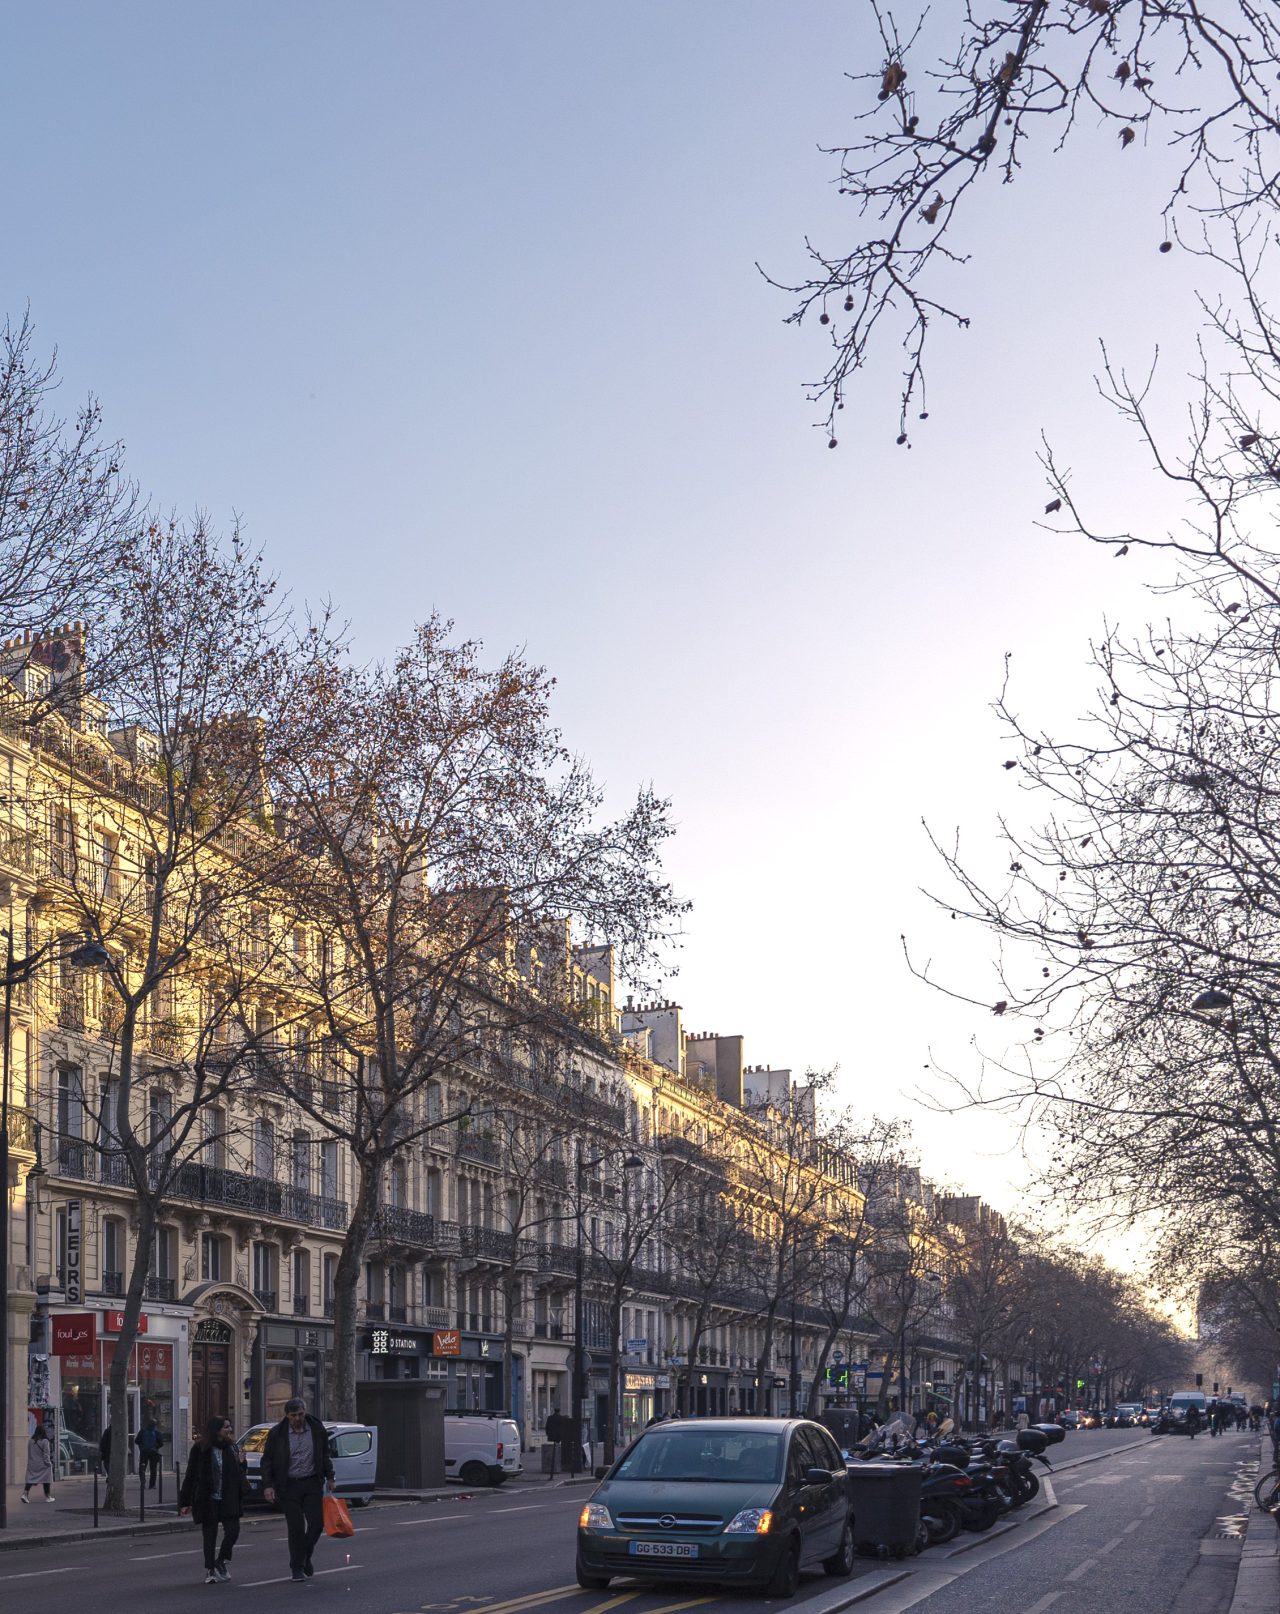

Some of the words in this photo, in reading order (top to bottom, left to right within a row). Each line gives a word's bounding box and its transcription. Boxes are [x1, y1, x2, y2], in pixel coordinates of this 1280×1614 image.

[67, 1201, 80, 1302] FLEURS
[371, 1330, 380, 1354] back
[380, 1329, 389, 1354] pack
[395, 1338, 417, 1349] STATION
[436, 1331, 457, 1347] Vélo
